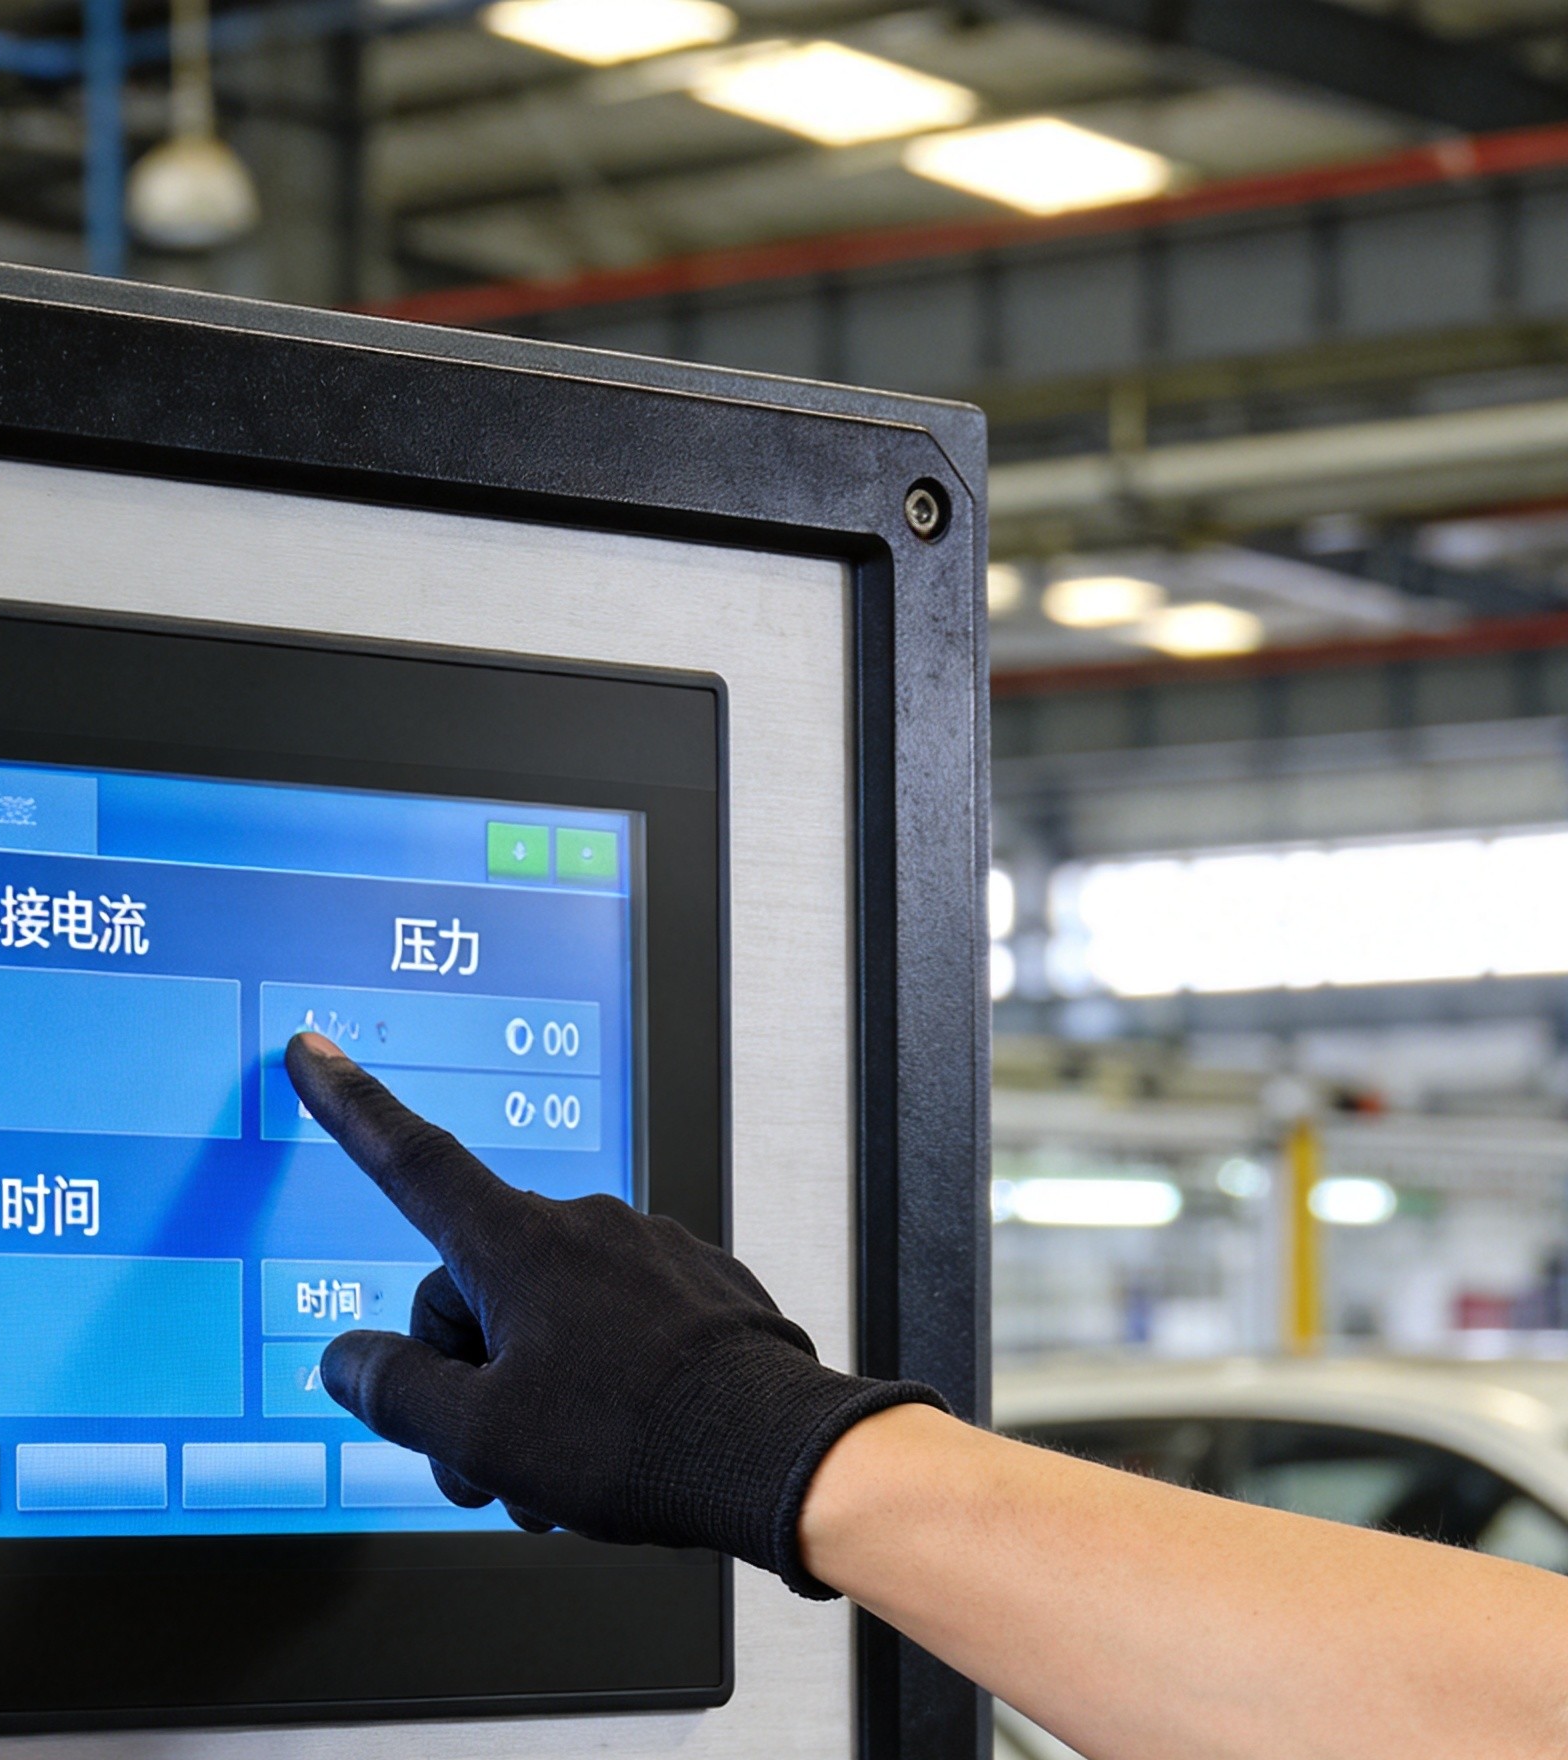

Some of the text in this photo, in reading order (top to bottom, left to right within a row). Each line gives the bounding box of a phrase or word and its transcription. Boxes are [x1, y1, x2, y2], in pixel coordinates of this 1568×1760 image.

[391, 917, 479, 975] 压力
[1, 1173, 100, 1236] 时间
[296, 1279, 363, 1321] 时间
